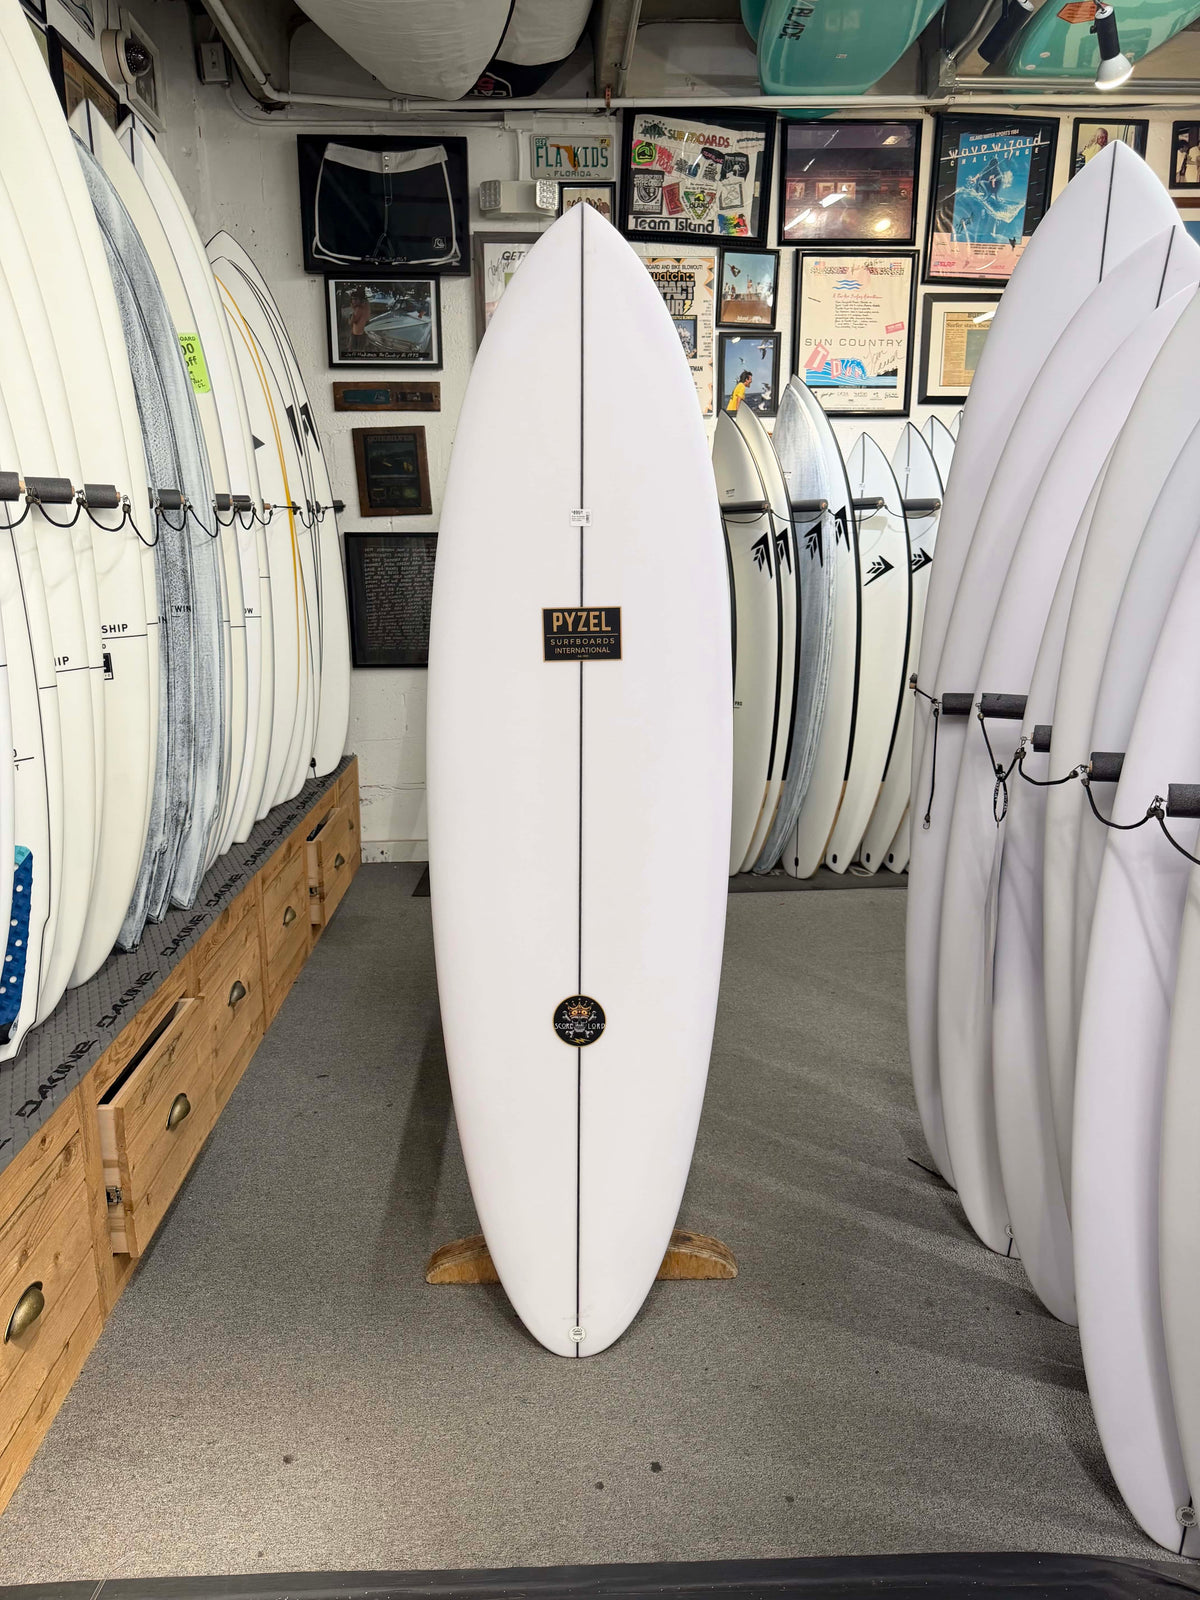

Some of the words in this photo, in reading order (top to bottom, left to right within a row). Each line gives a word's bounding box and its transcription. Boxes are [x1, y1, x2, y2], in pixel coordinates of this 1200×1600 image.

[535, 146, 563, 168] FLA
[573, 146, 609, 168] KIDS
[554, 170, 591, 178] FLORIDA
[633, 216, 671, 231] Team
[674, 217, 715, 234] Island
[804, 338, 833, 346] SUN
[838, 338, 903, 347] COUNTRY
[101, 624, 128, 634] SHIP
[552, 611, 611, 632] PYZEL
[554, 646, 610, 654] INTERNATIONAL
[95, 970, 159, 1029] DAKINE
[15, 1039, 99, 1118] DAKINE
